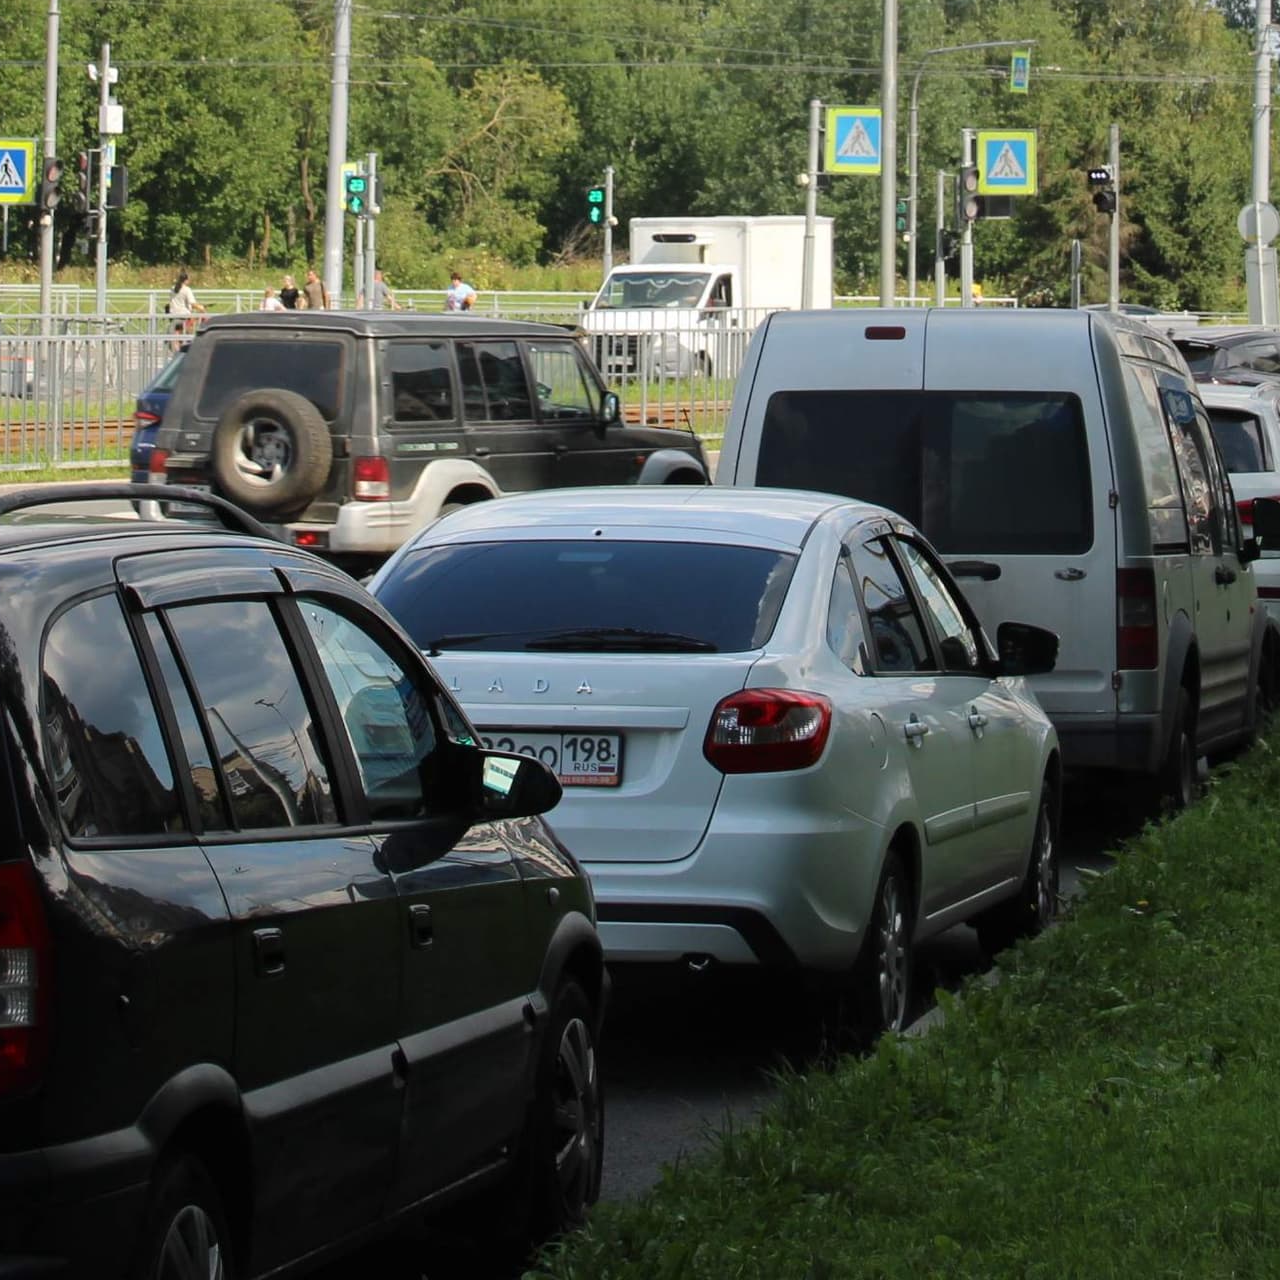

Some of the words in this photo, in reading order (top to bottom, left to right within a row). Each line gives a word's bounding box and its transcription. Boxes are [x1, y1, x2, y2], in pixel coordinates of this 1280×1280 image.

[449, 676, 592, 694] LADA
[564, 736, 612, 763] 198
[573, 762, 599, 773] RUS
